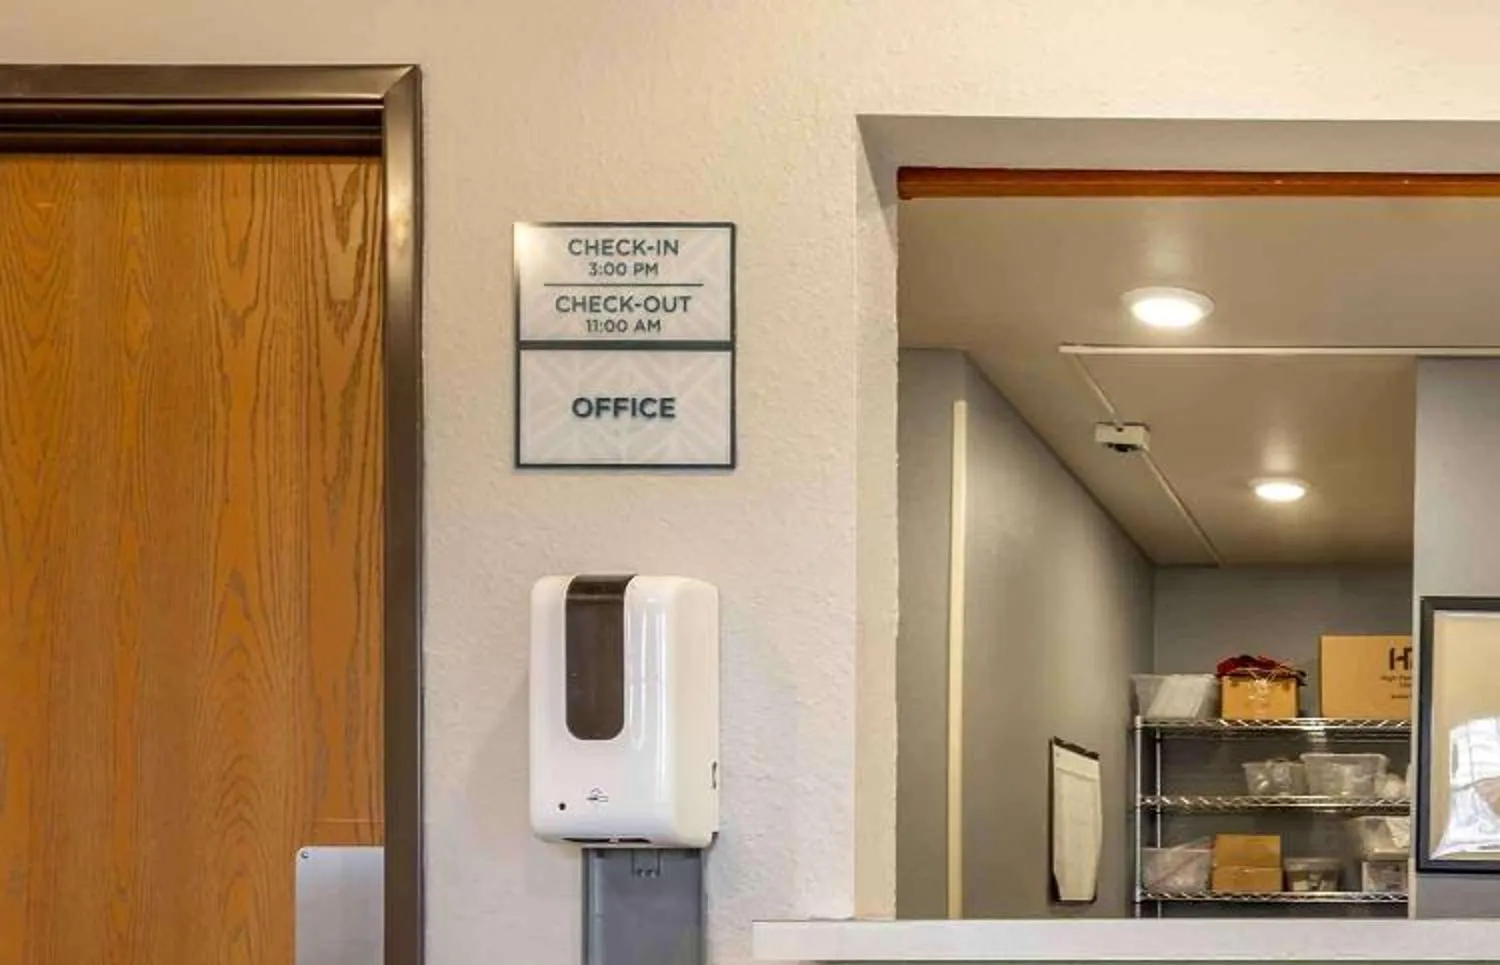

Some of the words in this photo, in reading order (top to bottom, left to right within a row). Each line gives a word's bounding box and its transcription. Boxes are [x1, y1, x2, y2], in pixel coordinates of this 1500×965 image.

[567, 238, 679, 256] CHECK-IN
[588, 261, 627, 277] 3:00
[633, 261, 659, 277] PM
[555, 295, 692, 313] CHECK-OUT
[586, 318, 628, 333] 11:00
[634, 318, 661, 333] AM
[571, 396, 676, 418] OFFICE
